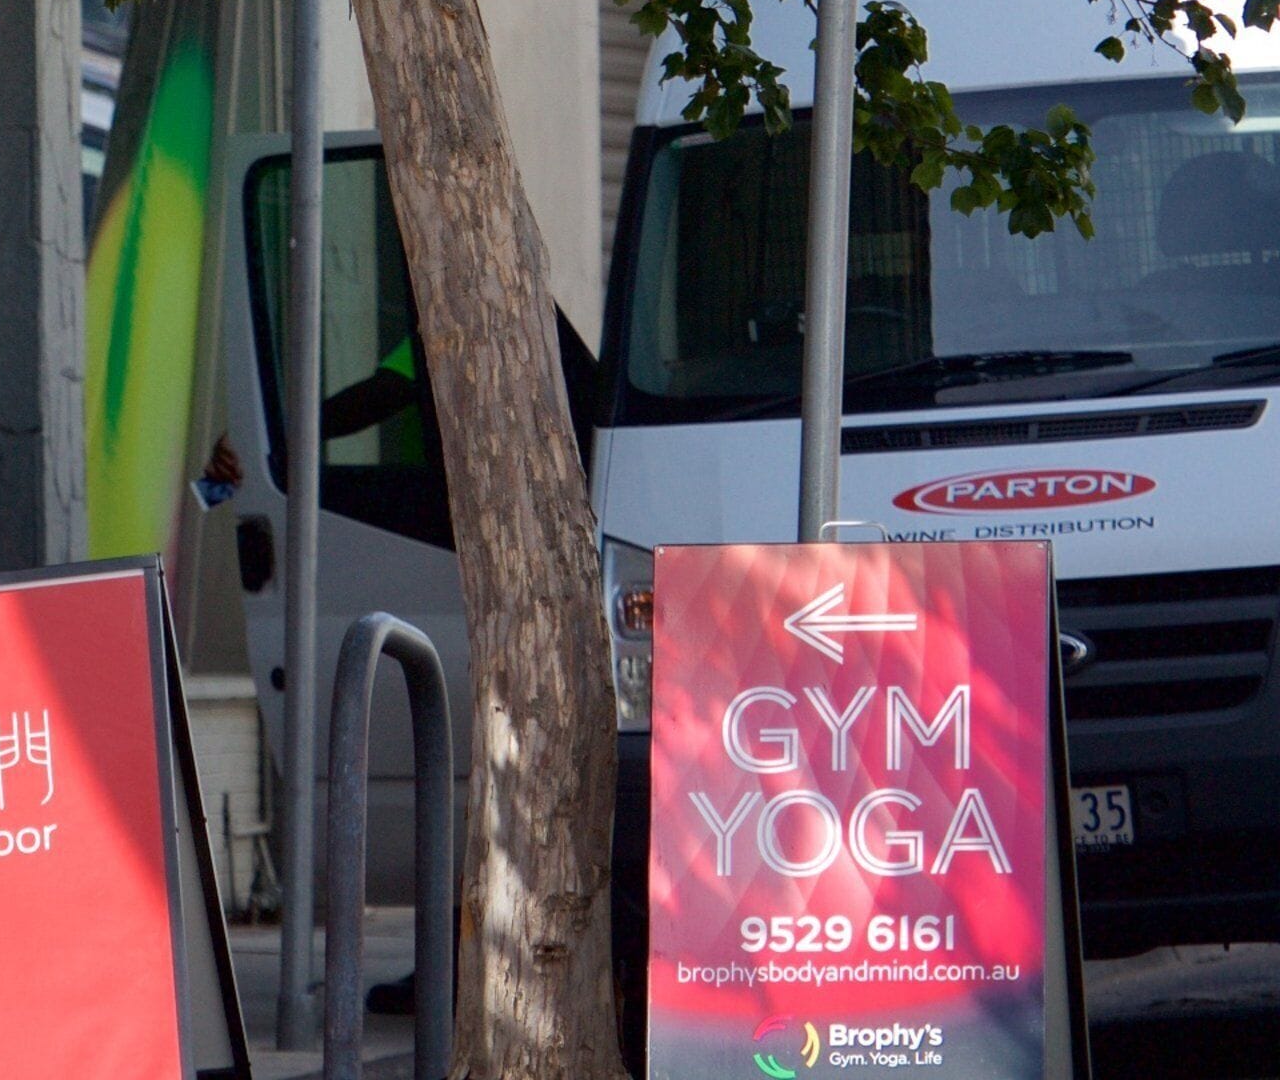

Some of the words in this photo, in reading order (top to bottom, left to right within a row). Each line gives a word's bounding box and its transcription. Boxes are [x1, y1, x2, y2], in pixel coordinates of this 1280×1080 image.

[945, 473, 1134, 504] PARTON
[974, 516, 1155, 540] DISTRIBUTION
[721, 684, 972, 775] GYM
[688, 787, 1013, 878] YOGA
[740, 915, 853, 953] 9529
[867, 914, 956, 952] 6161
[677, 959, 1021, 988] brophysbodyandmind.com.au
[828, 1023, 943, 1050] Brophy's
[828, 1052, 867, 1067] Gym.
[870, 1051, 911, 1067] Yoga.
[914, 1051, 942, 1065] Life
